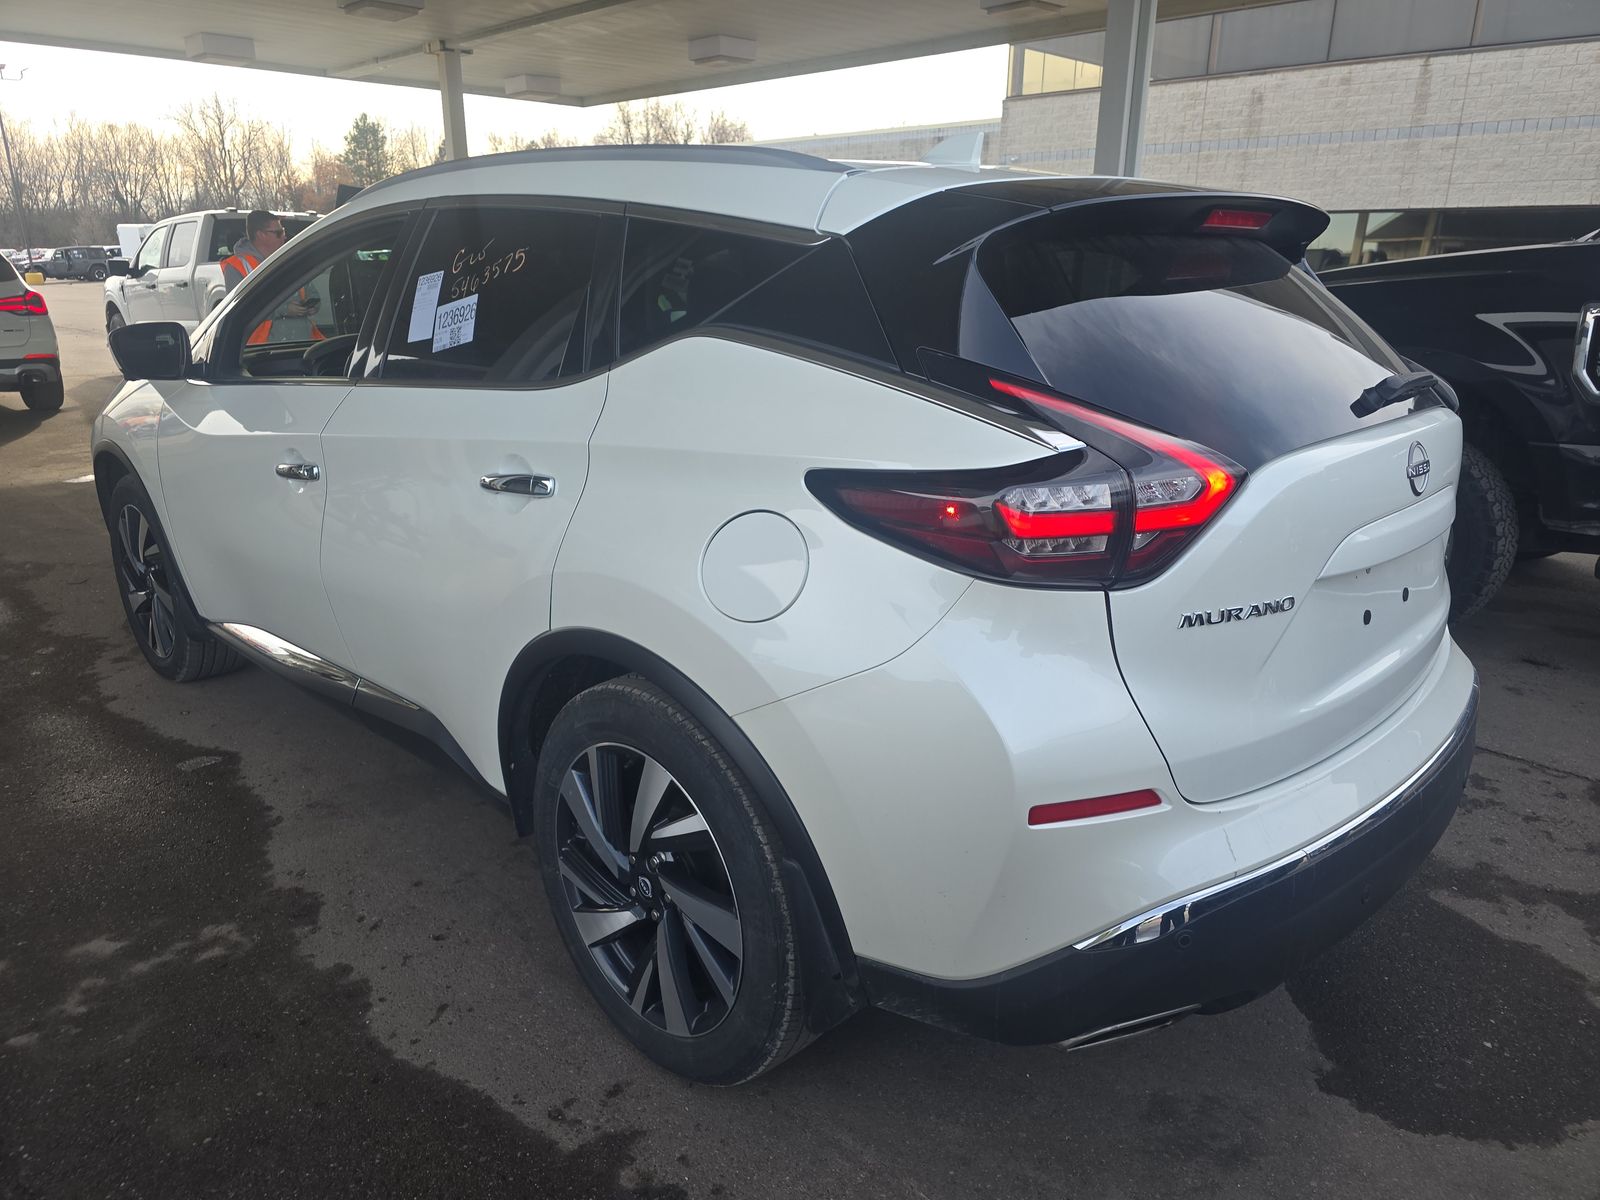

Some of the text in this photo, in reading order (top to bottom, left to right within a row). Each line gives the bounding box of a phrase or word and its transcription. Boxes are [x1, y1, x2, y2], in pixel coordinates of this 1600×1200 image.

[438, 302, 477, 330] 1236926
[1408, 461, 1430, 477] NISS
[1177, 596, 1296, 629] MURANO
